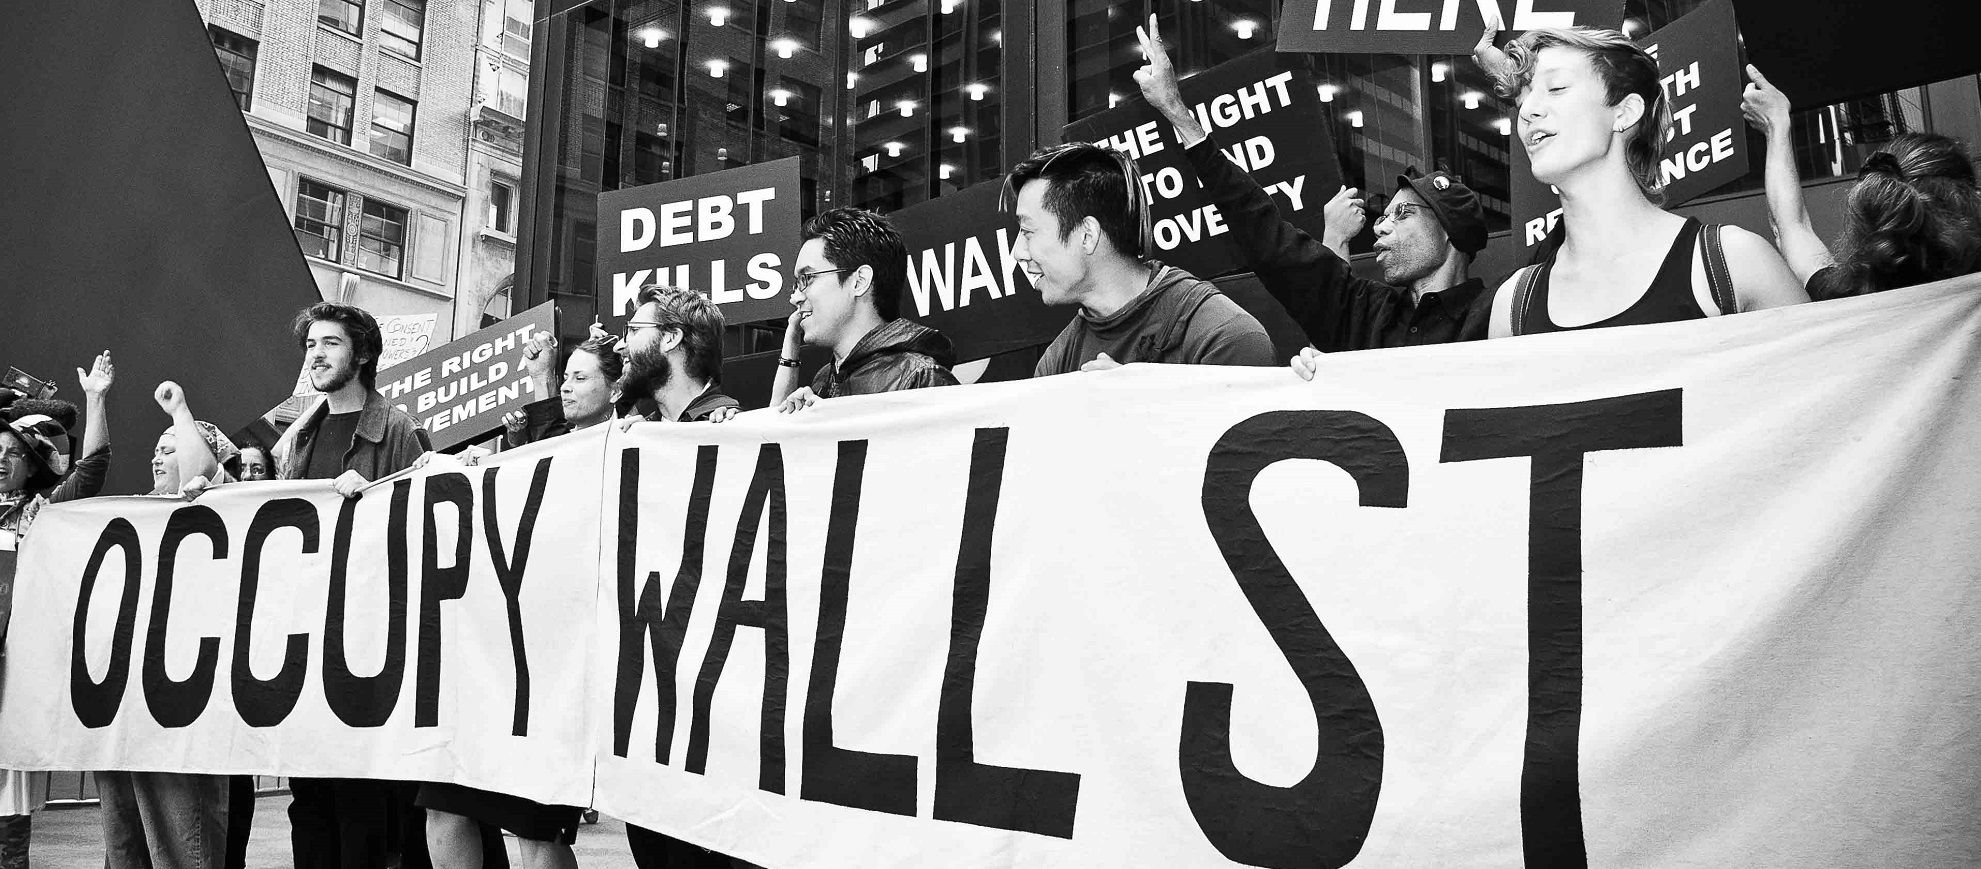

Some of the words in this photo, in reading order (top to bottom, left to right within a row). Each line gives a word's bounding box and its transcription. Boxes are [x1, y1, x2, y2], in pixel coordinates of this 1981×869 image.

[1093, 120, 1164, 160] HE
[1172, 70, 1293, 144] IGHT
[1197, 135, 1275, 189] ND
[620, 187, 776, 253] DEBT
[376, 367, 432, 400] THE
[441, 323, 536, 379] RIGHT
[417, 361, 509, 413] BUILD
[70, 456, 553, 737] OCCUPY
[613, 426, 1082, 840] WALL
[1178, 387, 1684, 869] ST
